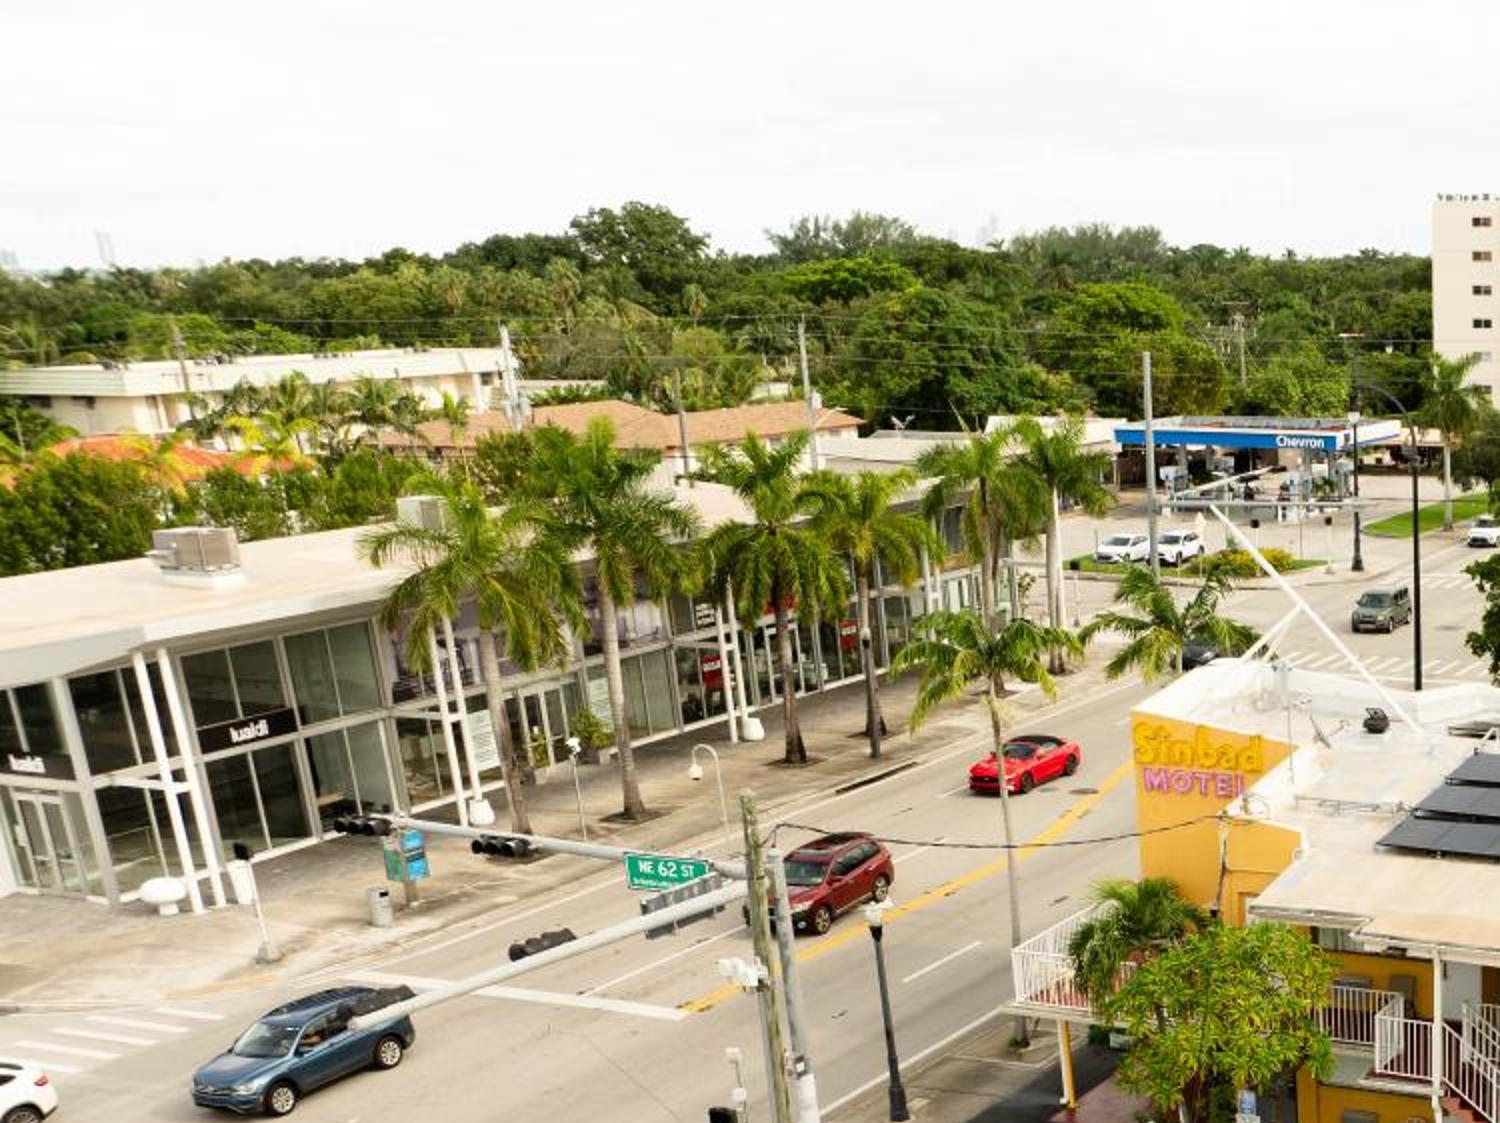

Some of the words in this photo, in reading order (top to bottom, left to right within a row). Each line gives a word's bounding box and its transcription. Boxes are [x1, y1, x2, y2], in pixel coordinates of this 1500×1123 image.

[1276, 436, 1325, 449] Chevron
[1134, 722, 1264, 772] Sinbad
[638, 860, 655, 873] NE
[658, 861, 678, 878] 62
[681, 864, 694, 877] ST
